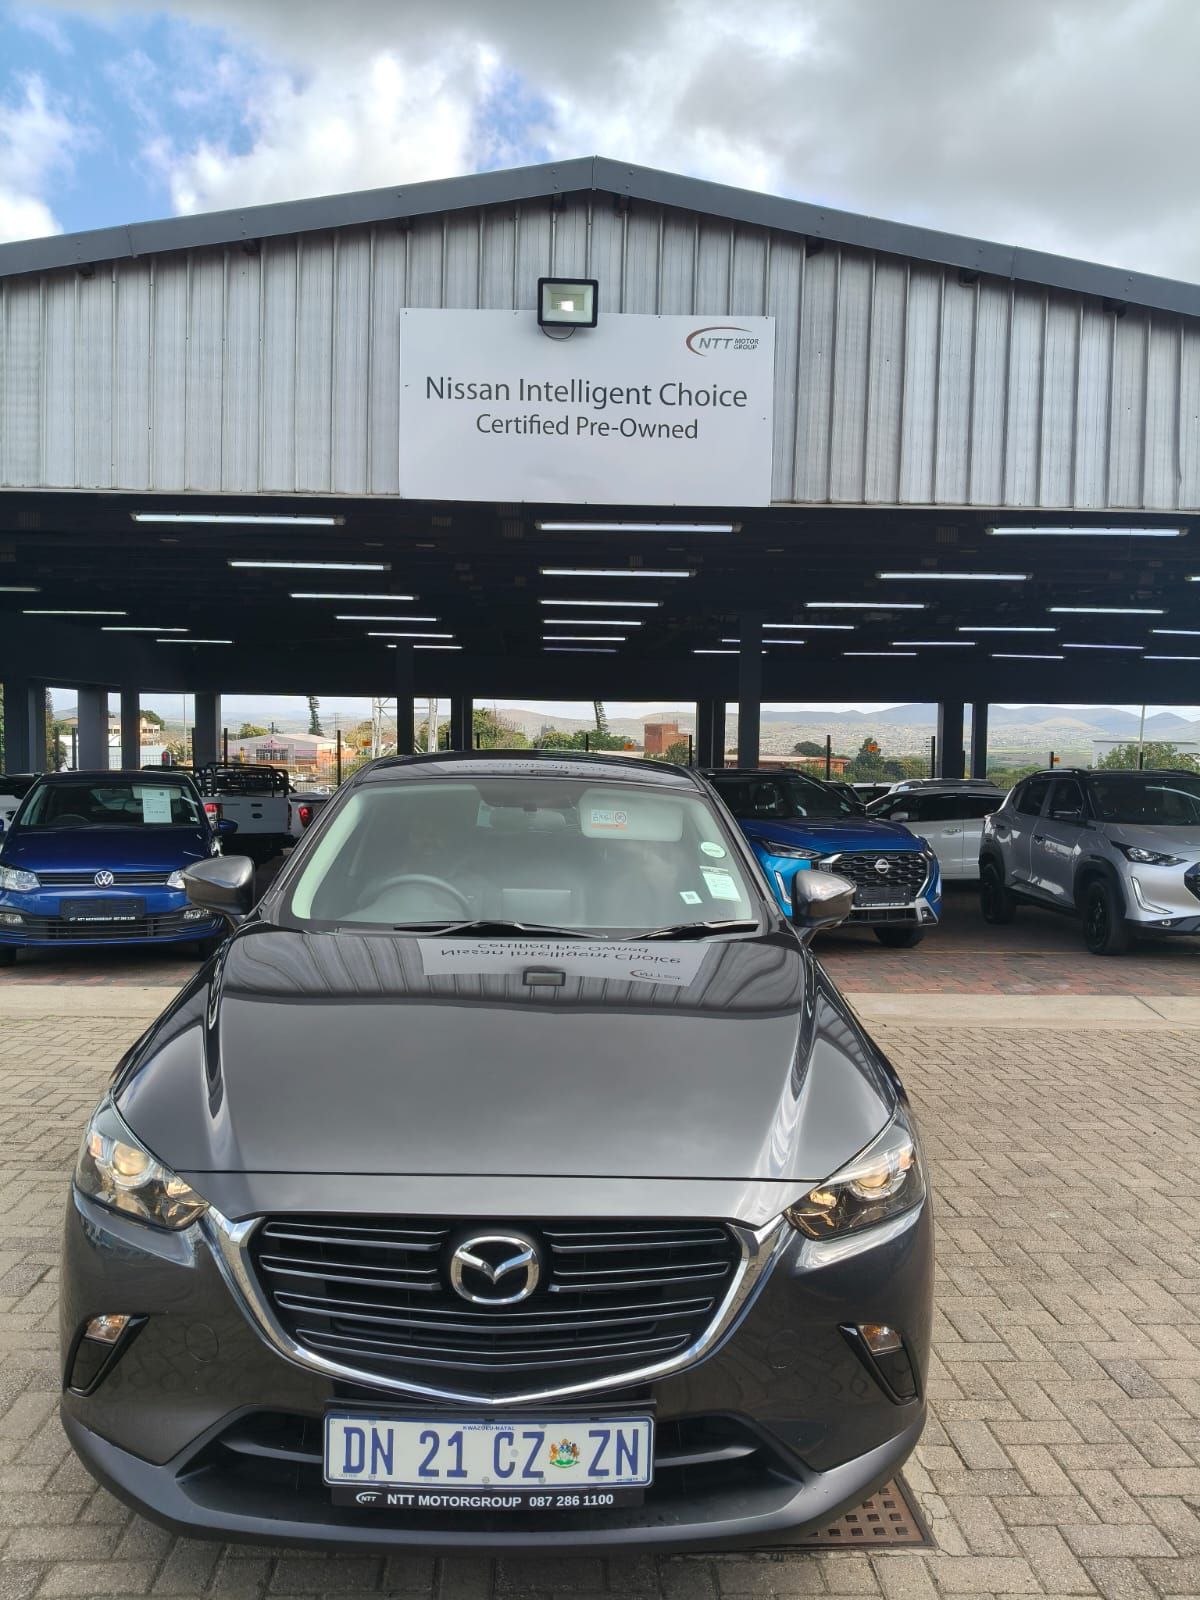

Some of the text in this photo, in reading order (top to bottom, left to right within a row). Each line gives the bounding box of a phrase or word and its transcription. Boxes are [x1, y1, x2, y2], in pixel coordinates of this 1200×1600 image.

[699, 337, 733, 349] NTT
[734, 337, 759, 345] MOTOR
[426, 376, 748, 409] Nissan Intelligent Choice
[476, 413, 699, 439] Certified Pre-Owned
[342, 1426, 639, 1479] DN 21 CZ ZN
[387, 1494, 614, 1507] NTT MOTORGROUP 087 286 1100
